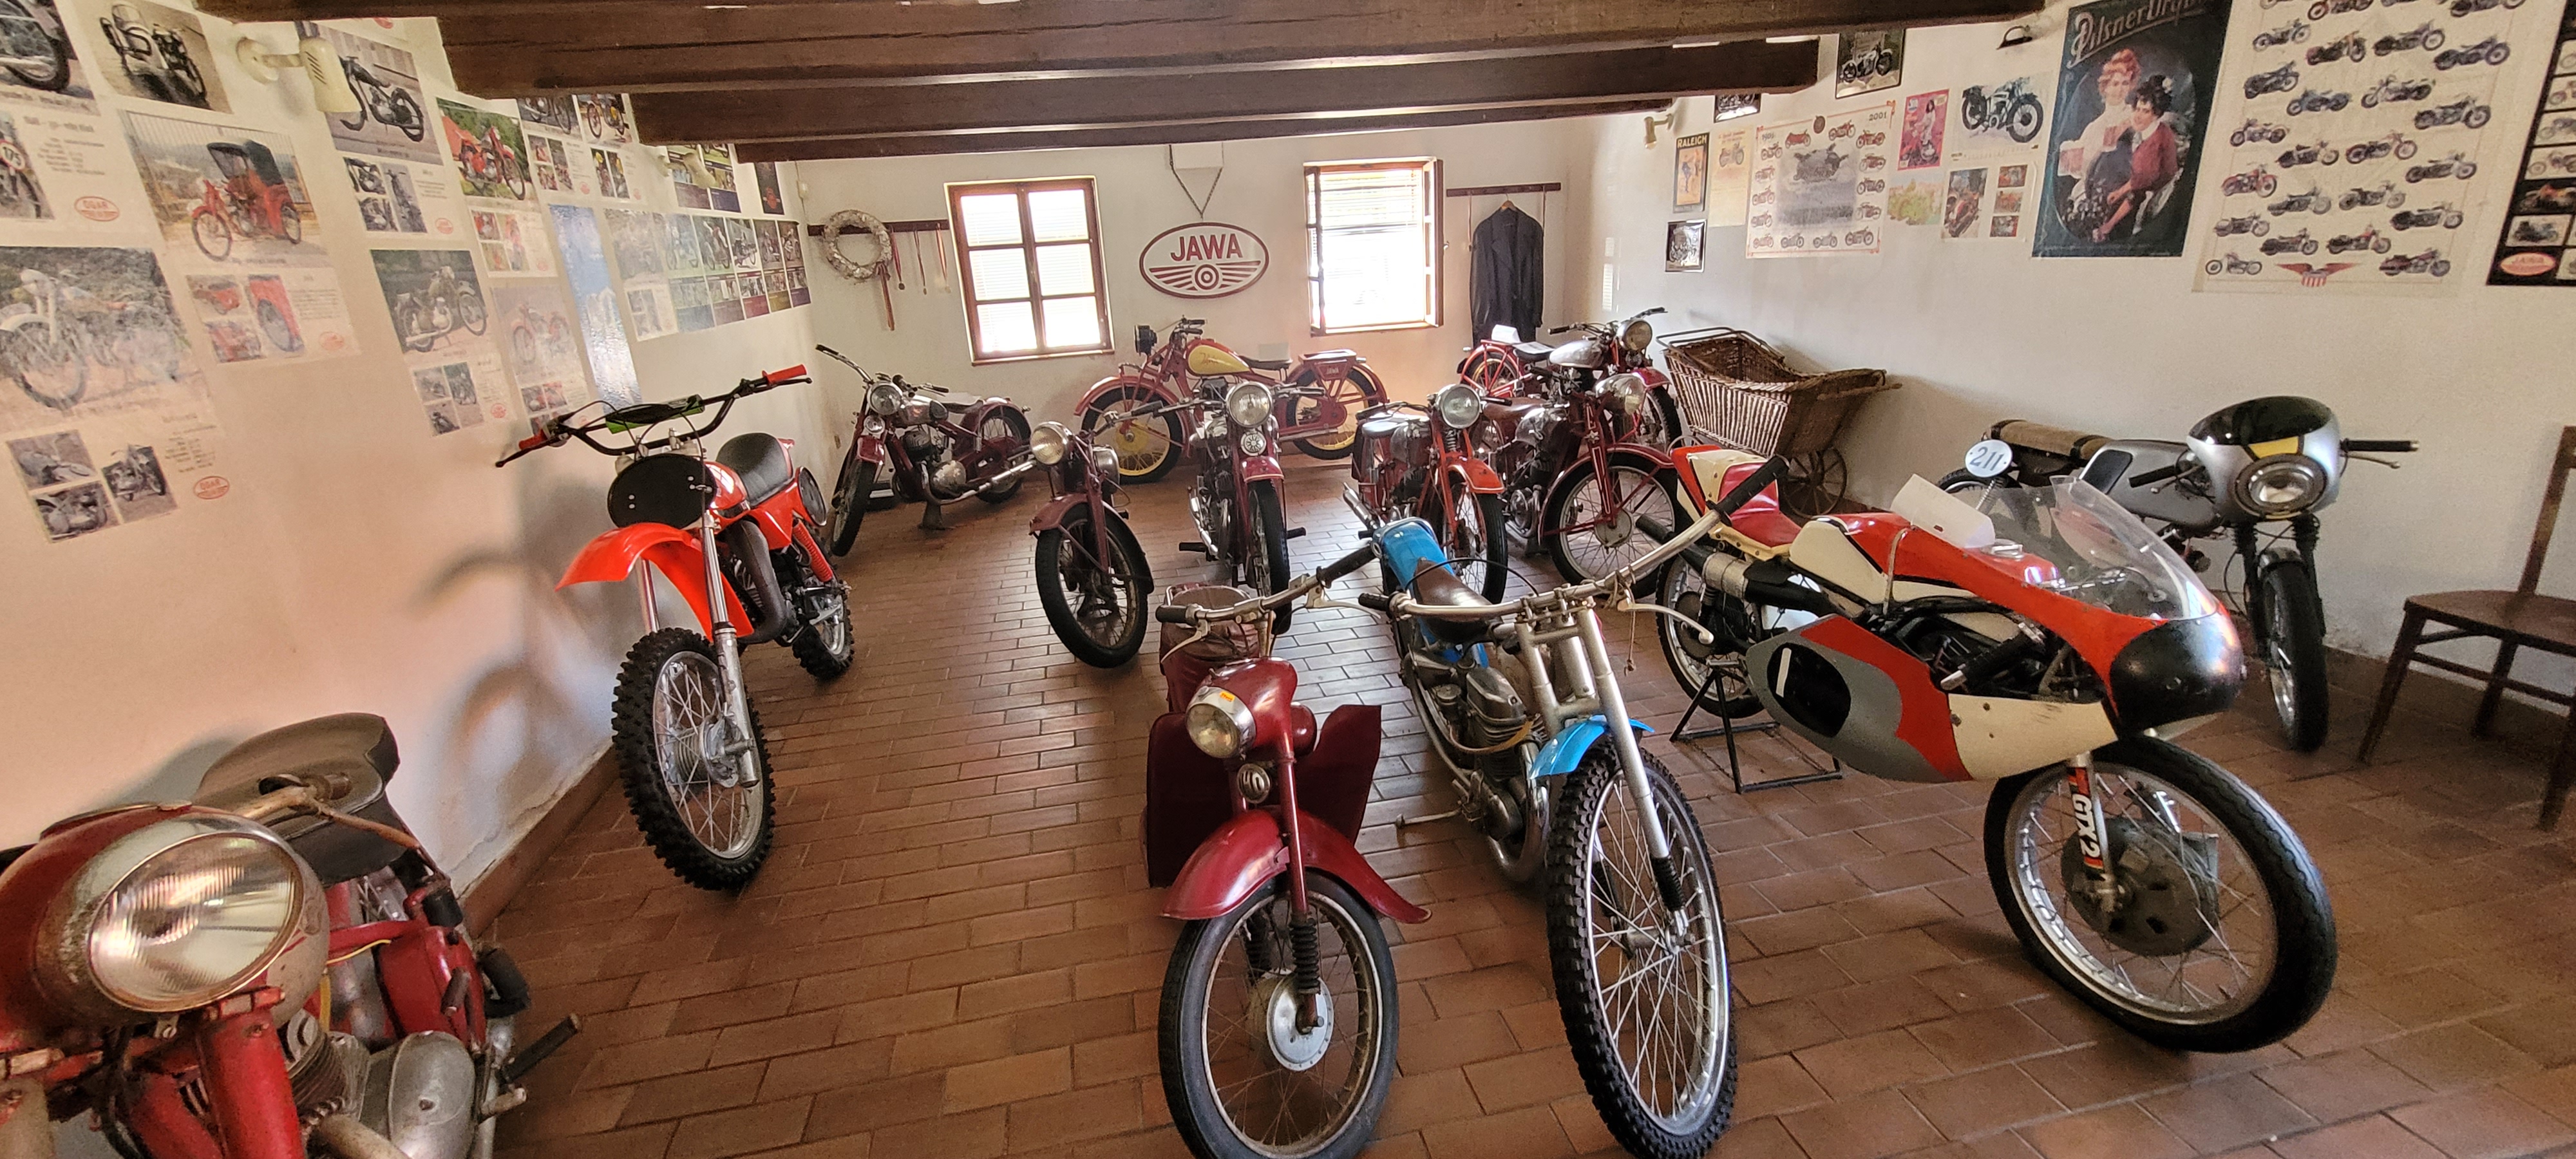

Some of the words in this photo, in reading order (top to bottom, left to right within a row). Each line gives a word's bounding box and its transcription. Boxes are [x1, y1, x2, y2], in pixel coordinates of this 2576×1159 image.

[2066, 5, 2148, 69] Pilsner
[1868, 111, 1887, 121] 2001
[1677, 134, 1708, 149] RALEIGH
[1170, 233, 1244, 261] JAWA
[1969, 446, 2005, 471] 211
